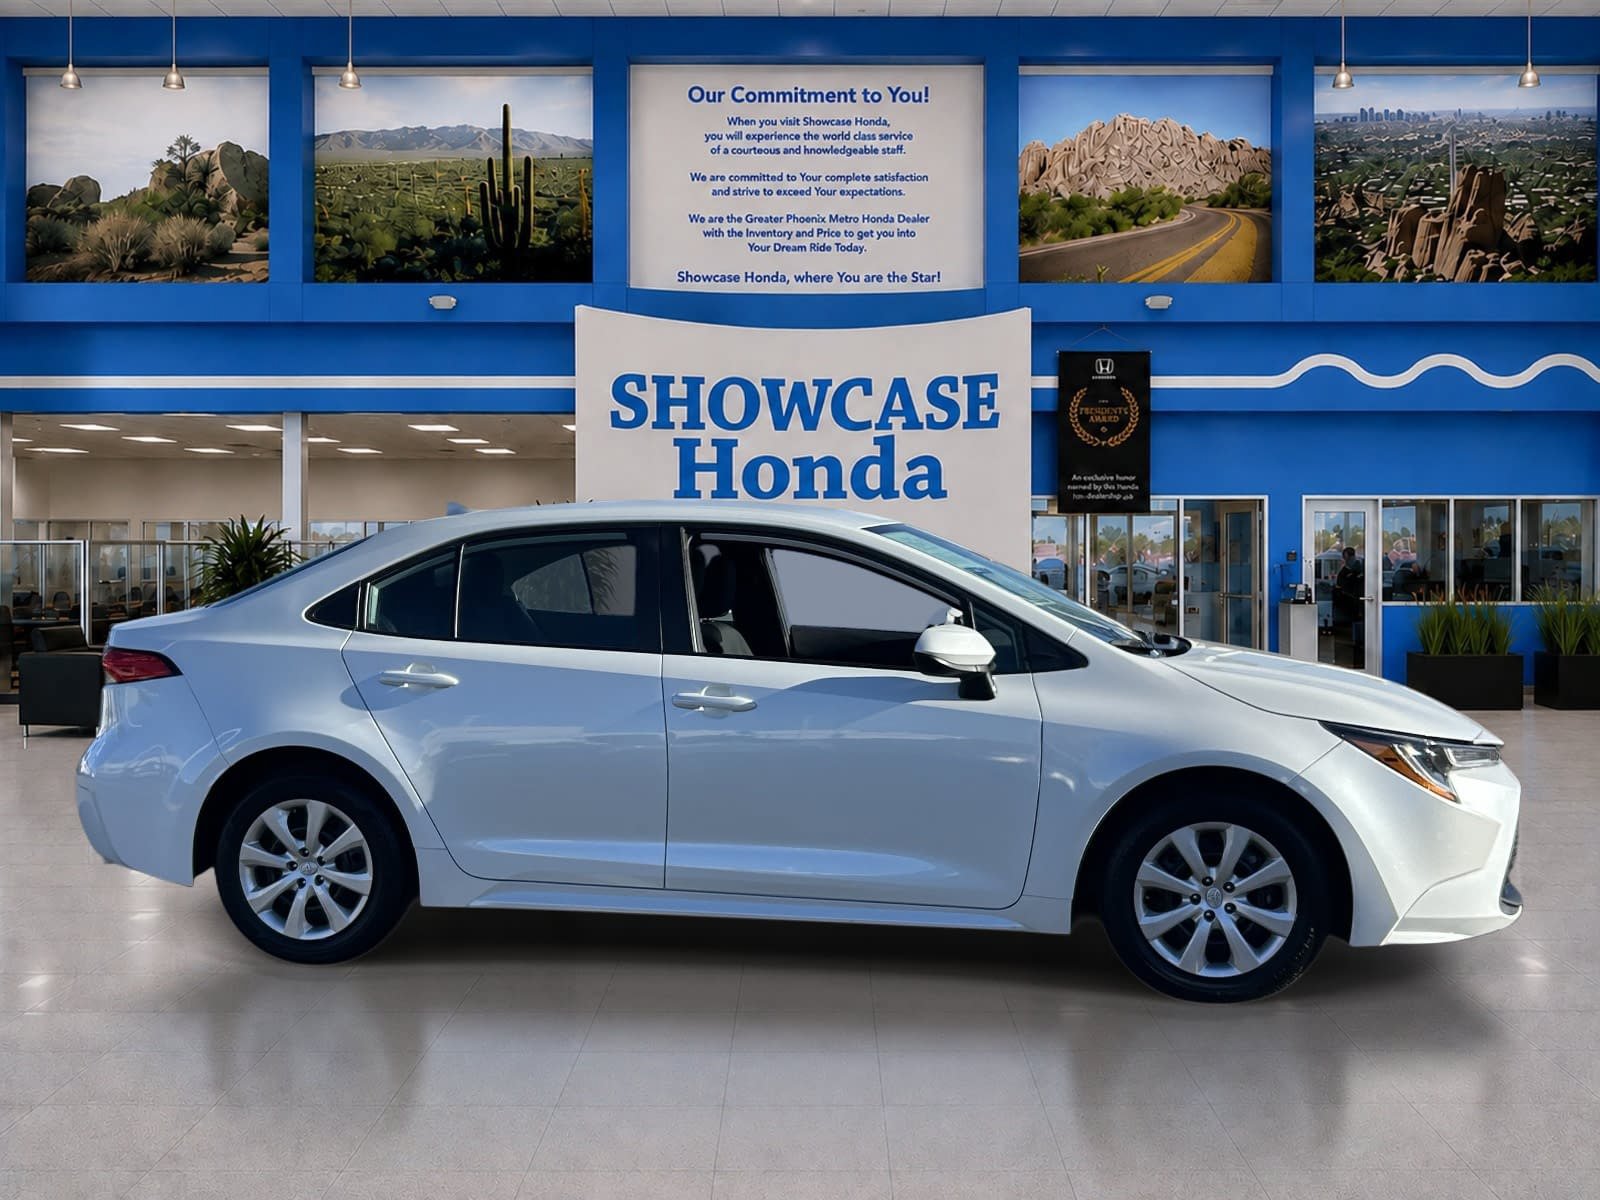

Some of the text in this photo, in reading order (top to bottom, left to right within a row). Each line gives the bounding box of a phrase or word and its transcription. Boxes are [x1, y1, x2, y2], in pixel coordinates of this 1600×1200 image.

[687, 85, 930, 104] Our Commitment to You!
[726, 115, 891, 129] When you visit Showcase Honda,
[703, 130, 914, 144] you will experience the world class service
[709, 144, 722, 156] of
[722, 147, 730, 156] a
[730, 146, 782, 156] courteous
[782, 144, 802, 155] and
[880, 143, 907, 156] staff.
[689, 171, 929, 185] We are committed to Your complete satisfaction
[711, 185, 906, 200] and strive to exceed Your expectations.
[687, 212, 931, 225] We are the Greater Phoenix Metro Honda Dealer
[702, 227, 917, 241] with the Inventory and Price to get you into
[747, 241, 868, 255] Your Dream Ride Today.
[676, 270, 941, 286] Showcase Honda, where You are the Star!
[609, 373, 1000, 431] SHOWCASE
[673, 434, 948, 500] Honda
